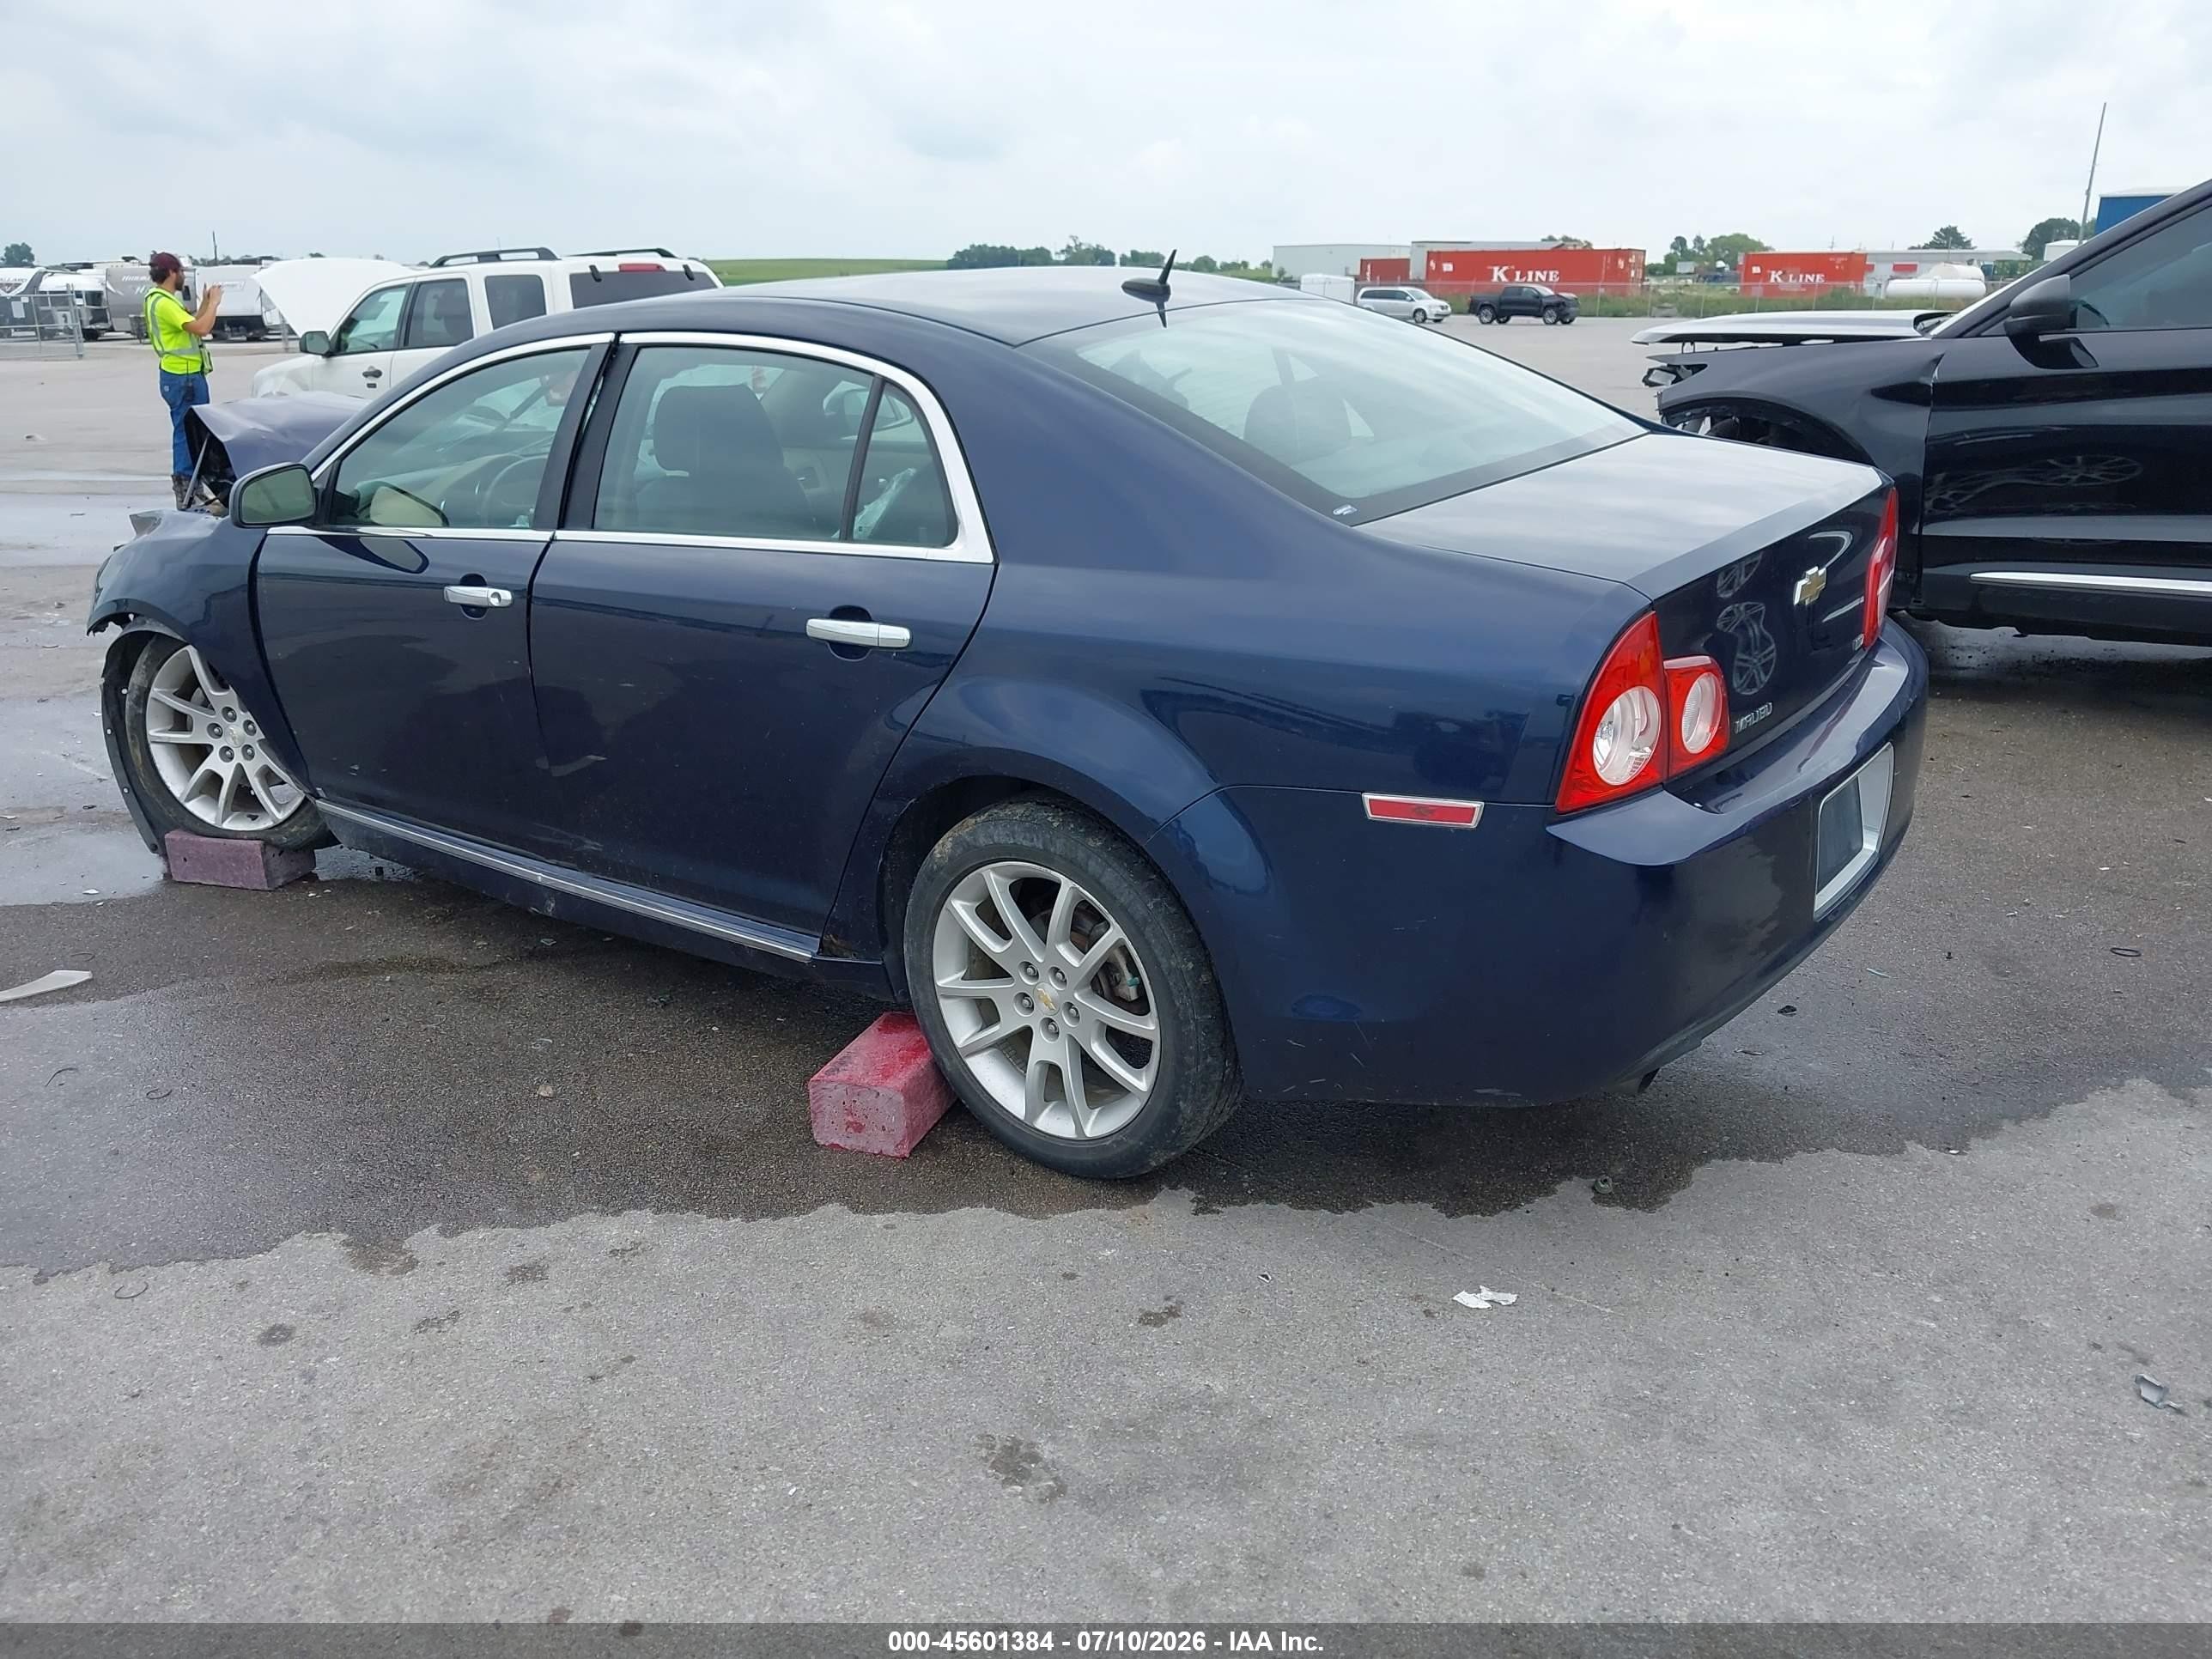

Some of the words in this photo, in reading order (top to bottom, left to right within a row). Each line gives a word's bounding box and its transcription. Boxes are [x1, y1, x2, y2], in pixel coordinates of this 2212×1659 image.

[1487, 265, 1510, 283] K
[1514, 270, 1560, 283] LINE
[1769, 270, 1784, 283] K
[1789, 273, 1826, 283] LINE
